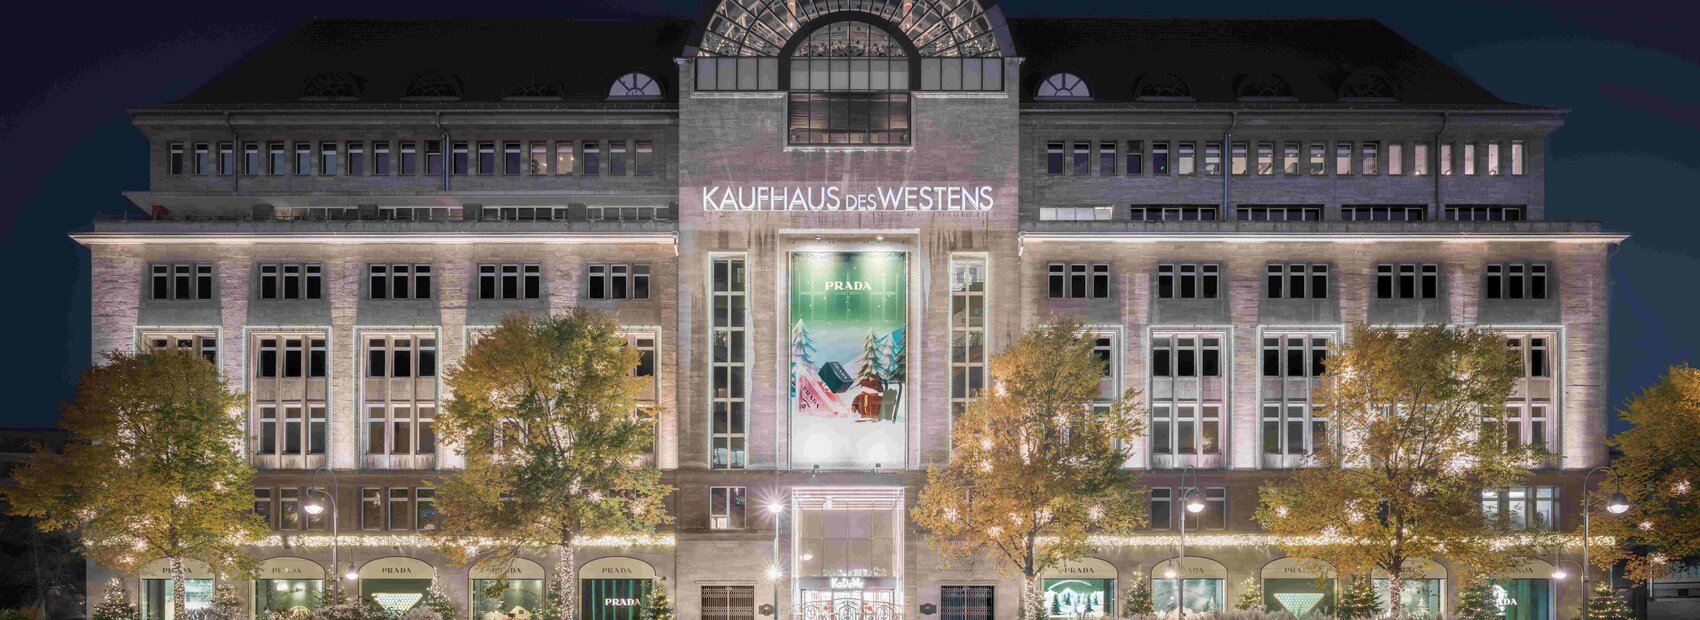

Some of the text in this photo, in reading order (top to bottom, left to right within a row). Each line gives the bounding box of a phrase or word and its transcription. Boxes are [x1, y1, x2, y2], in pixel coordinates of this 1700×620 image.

[703, 186, 994, 211] KAUFHAUS DES WESTENS
[825, 281, 872, 291] PRADA
[803, 386, 820, 409] PRADA
[831, 577, 865, 589] KaDeWe
[605, 598, 641, 606] PRADA
